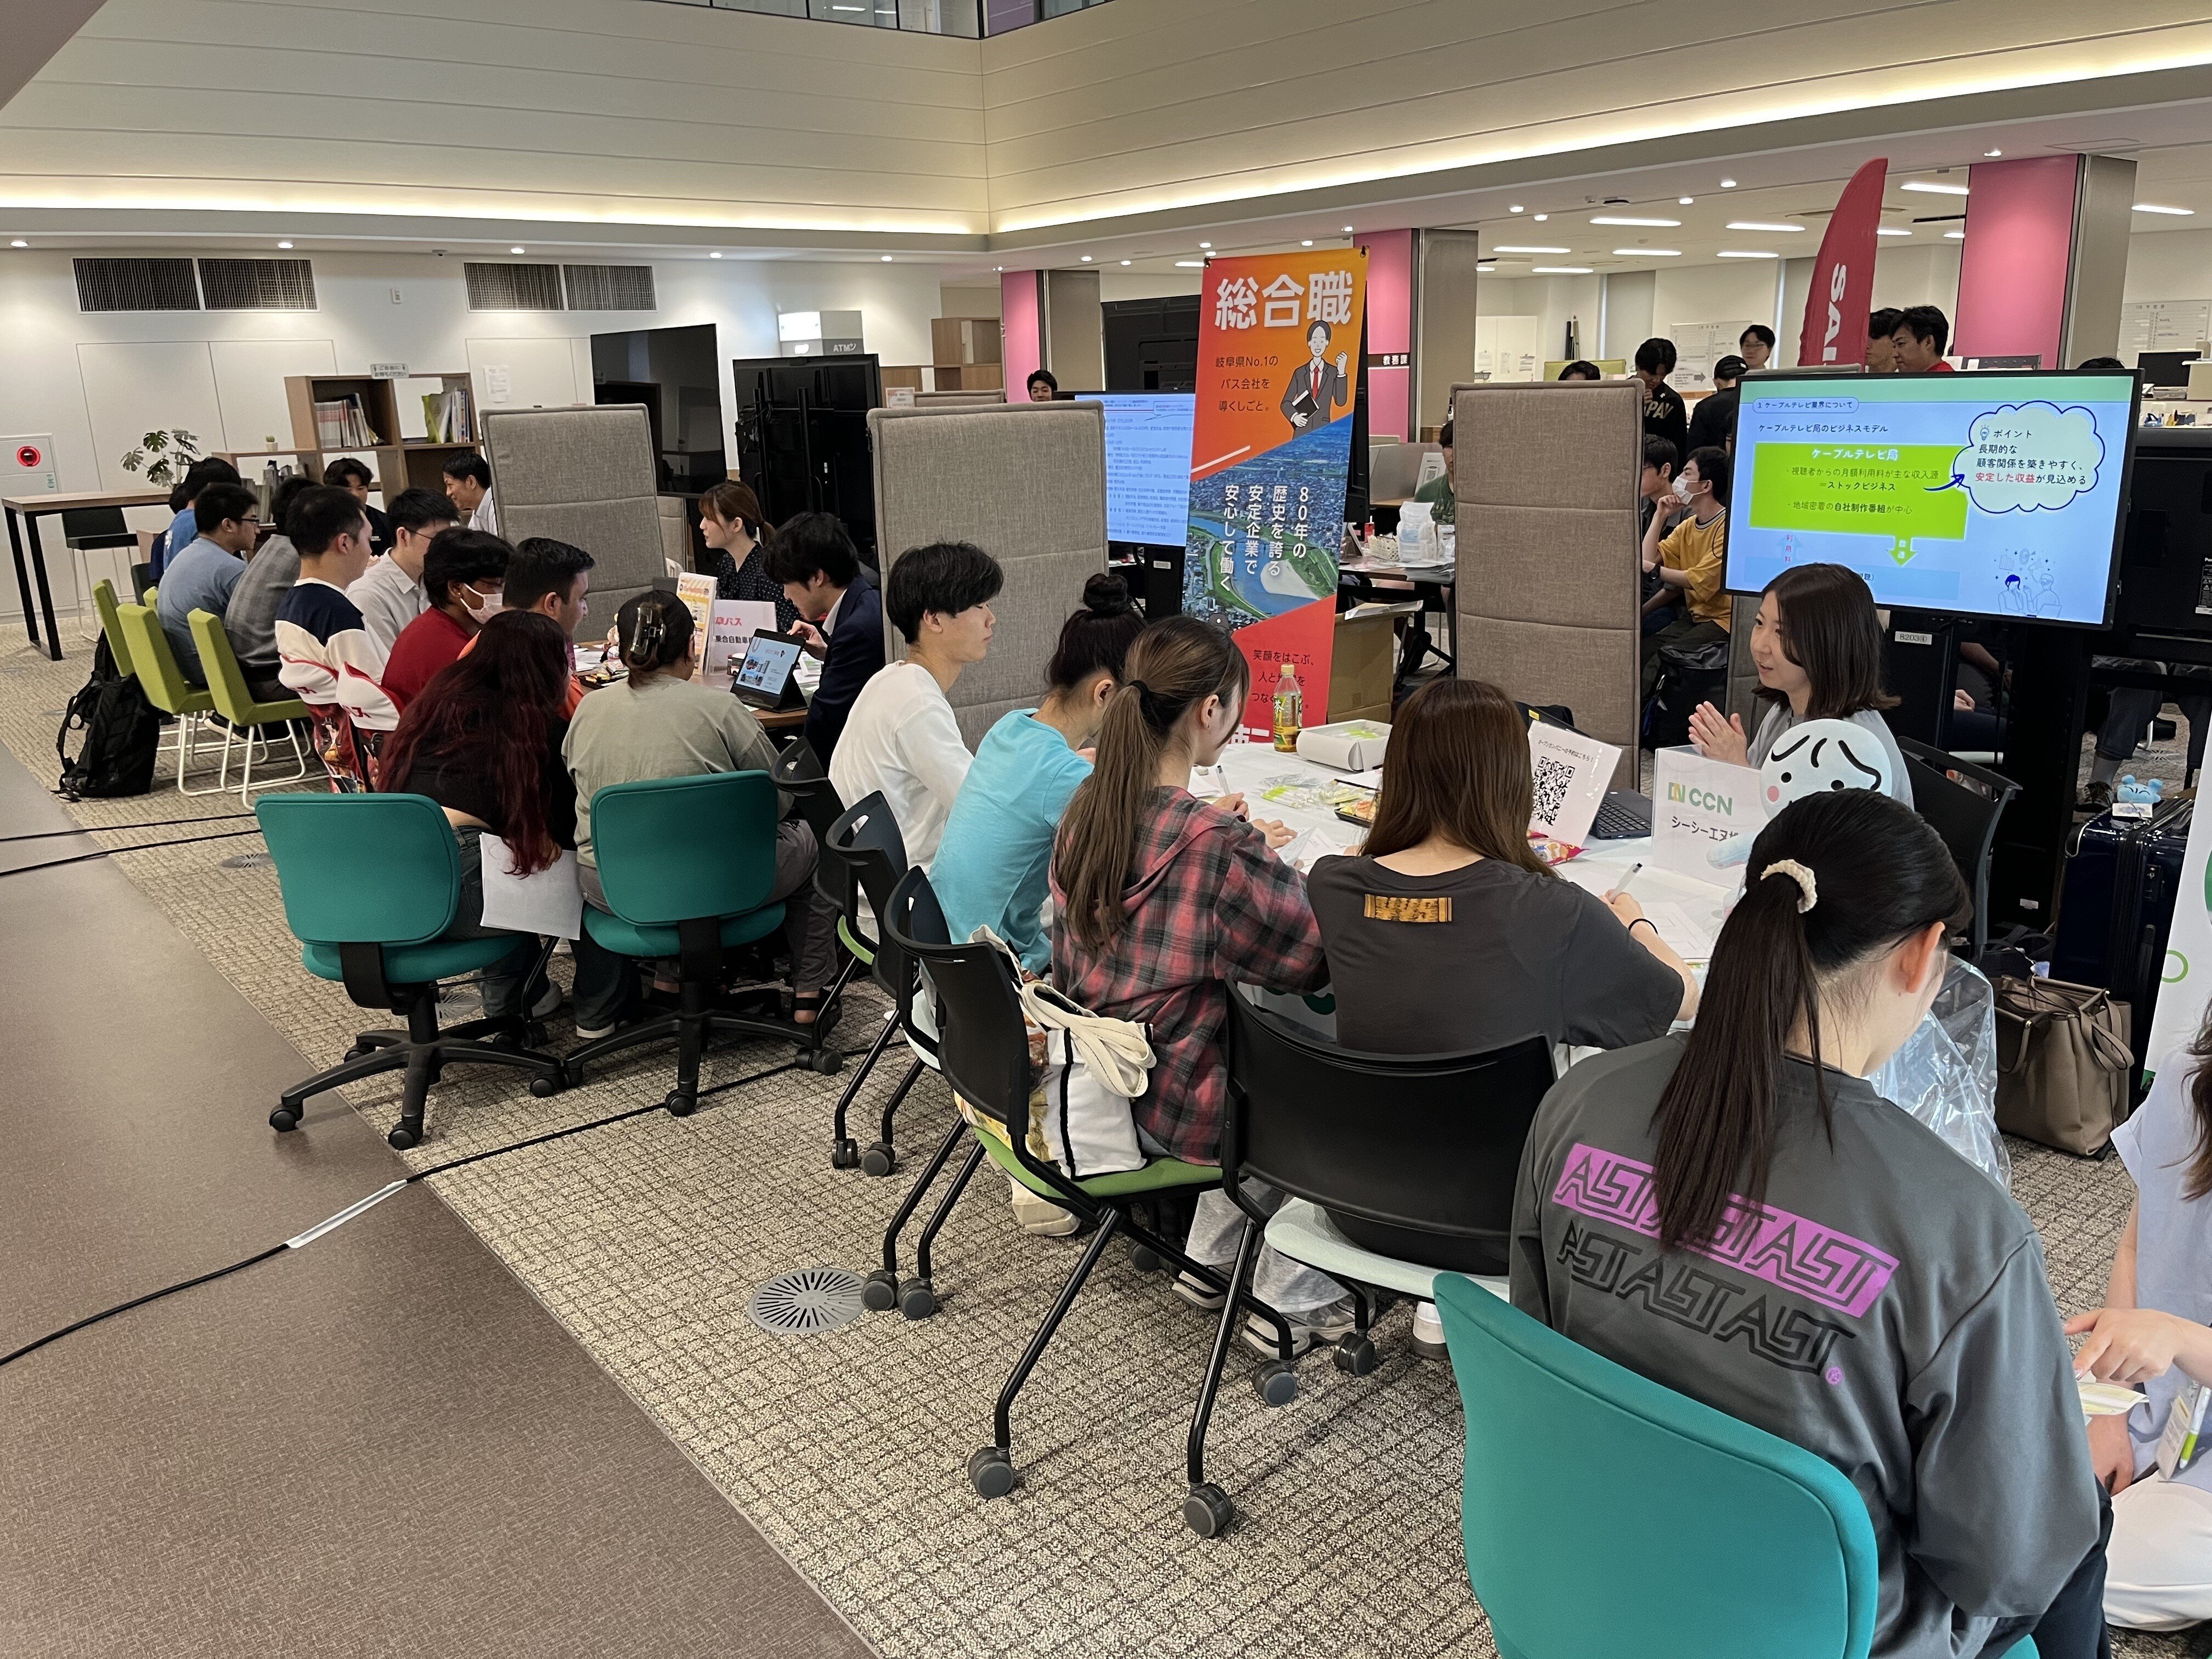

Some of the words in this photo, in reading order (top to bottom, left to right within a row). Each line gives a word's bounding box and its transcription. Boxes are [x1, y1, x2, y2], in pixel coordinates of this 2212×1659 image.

[1215, 270, 1353, 330] 総合職
[833, 343, 851, 352] ATM
[1216, 356, 1278, 368] 岐阜県No.1の
[1221, 378, 1270, 390] バス会社を
[1219, 400, 1269, 412] 導くしごと。
[1759, 424, 1888, 433] ケーブルテレビ局のビジネスモデル
[1993, 430, 2032, 438] ポイント
[1812, 448, 1899, 461] ケーブルテレビ局
[1978, 444, 2017, 454] 長期的な
[1976, 458, 2083, 470] 顧客関係を築きやすく、
[1976, 472, 2086, 485] 安定した収益が見込める
[1245, 484, 1263, 574] 安定企業で
[1293, 487, 1309, 558] 80年の
[1268, 485, 1288, 576] 歴史を誇る
[1220, 484, 1239, 591] 安心して働く
[1253, 650, 1314, 665] 笑顔をはこぶ、
[1259, 671, 1306, 686] 人とを
[1689, 788, 1733, 816] CCN
